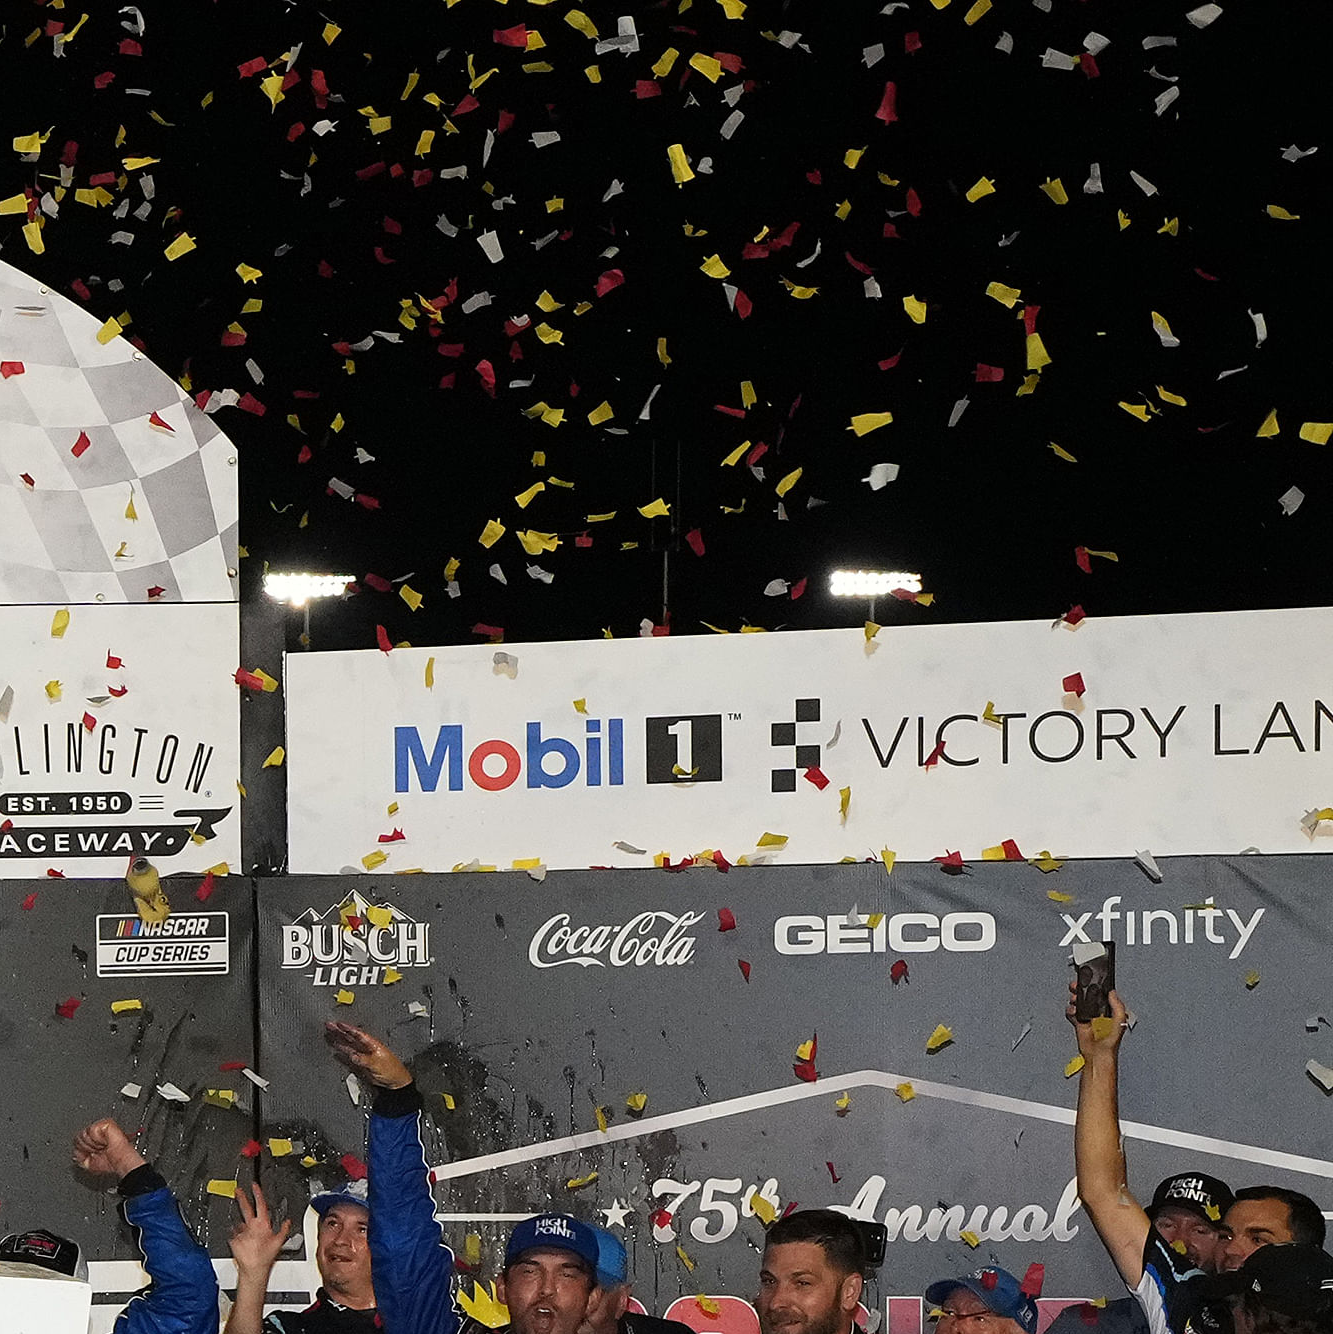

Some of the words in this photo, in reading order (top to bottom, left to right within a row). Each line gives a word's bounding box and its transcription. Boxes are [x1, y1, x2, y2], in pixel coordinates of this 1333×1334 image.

[394, 718, 624, 793] Mobil
[667, 721, 693, 778] 1
[862, 705, 1185, 769] VICTORY
[6, 795, 56, 813] EST.
[69, 794, 122, 813] 1950
[138, 917, 210, 939] NASCAR
[280, 921, 431, 970] BUSCH
[528, 911, 706, 969] Coca-Cola
[774, 911, 996, 955] GEICO
[1059, 896, 1265, 959] xfinity
[114, 944, 150, 963] CUP
[153, 943, 210, 963] SERIES
[1171, 1177, 1203, 1191] HIGH
